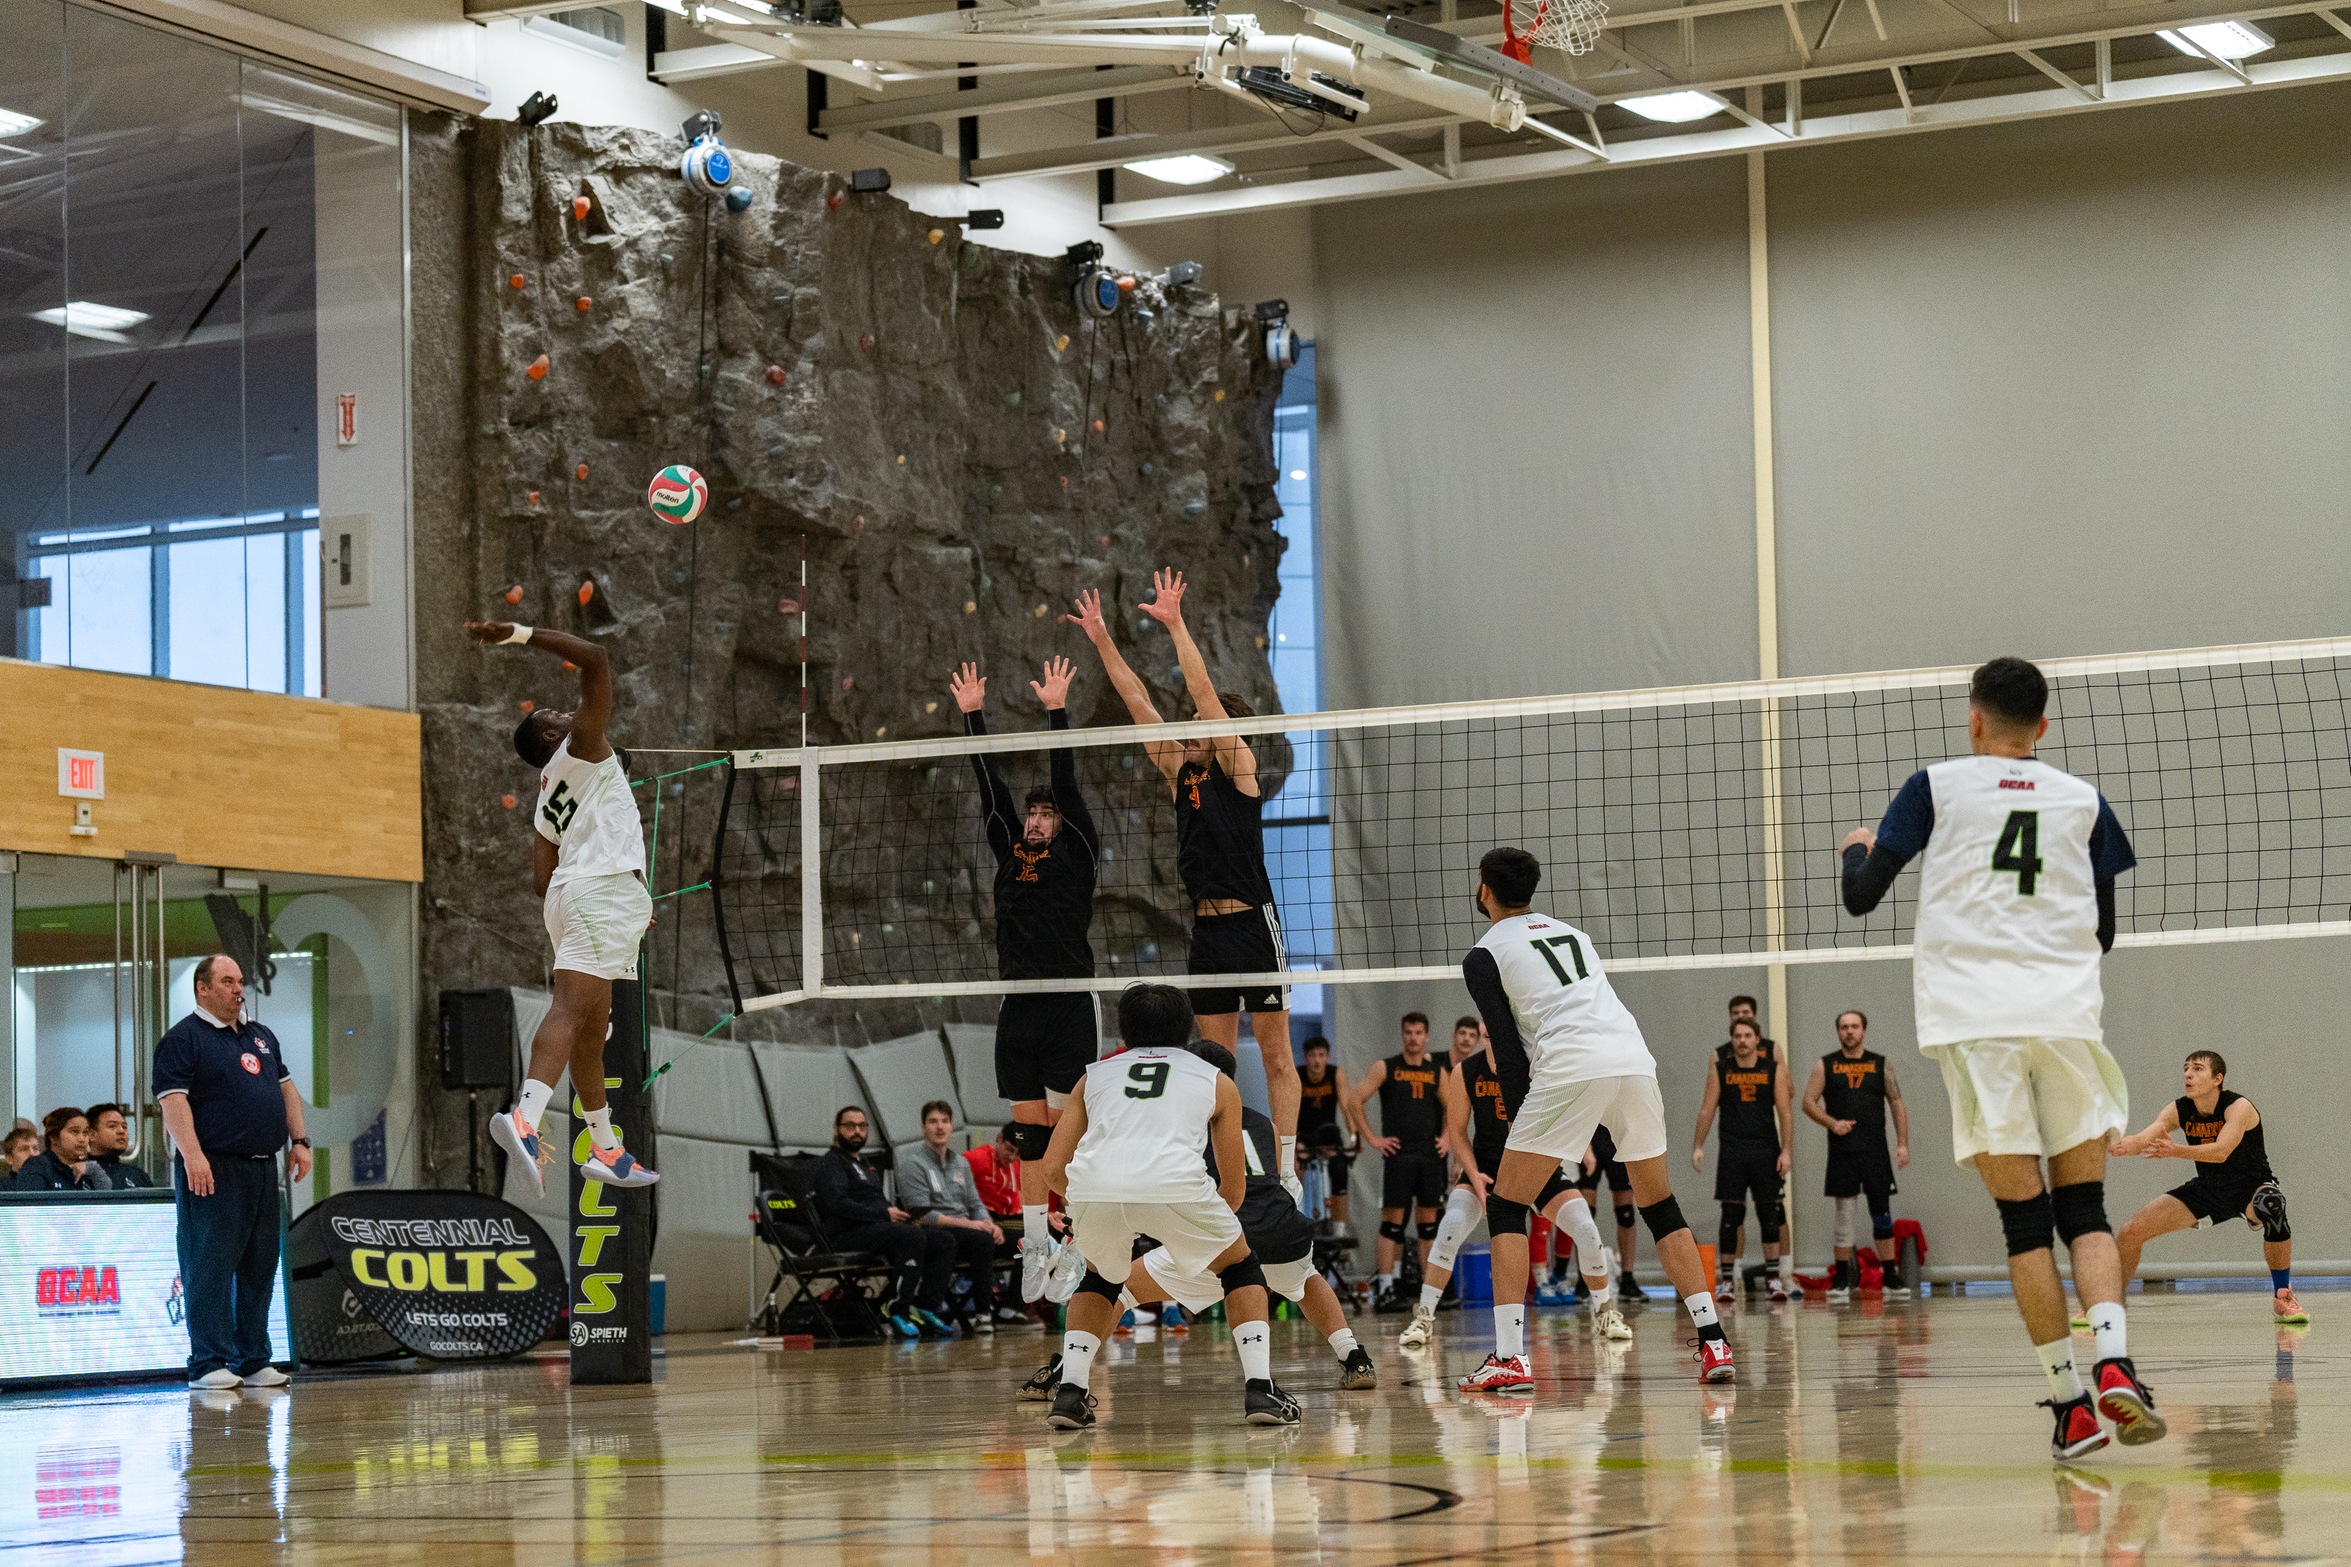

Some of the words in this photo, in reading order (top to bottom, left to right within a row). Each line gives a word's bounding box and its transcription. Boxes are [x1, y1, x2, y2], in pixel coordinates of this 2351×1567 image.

[656, 491, 680, 504] molten
[71, 757, 94, 790] EXIT
[1991, 810, 2043, 896] 4
[1529, 934, 1590, 987] 17
[1124, 1062, 1171, 1099] 9
[1846, 1073, 1865, 1088] 17
[768, 1200, 797, 1209] COLTS
[331, 1216, 530, 1246] CENTENNIAL
[351, 1248, 537, 1291] COLTS
[37, 1265, 120, 1306] OCAA
[406, 1312, 439, 1326] LETS
[440, 1313, 460, 1326] GO
[462, 1313, 508, 1327] COLTS
[590, 1327, 628, 1338] SPIETH
[429, 1341, 484, 1351] GOCOLTS.CA
